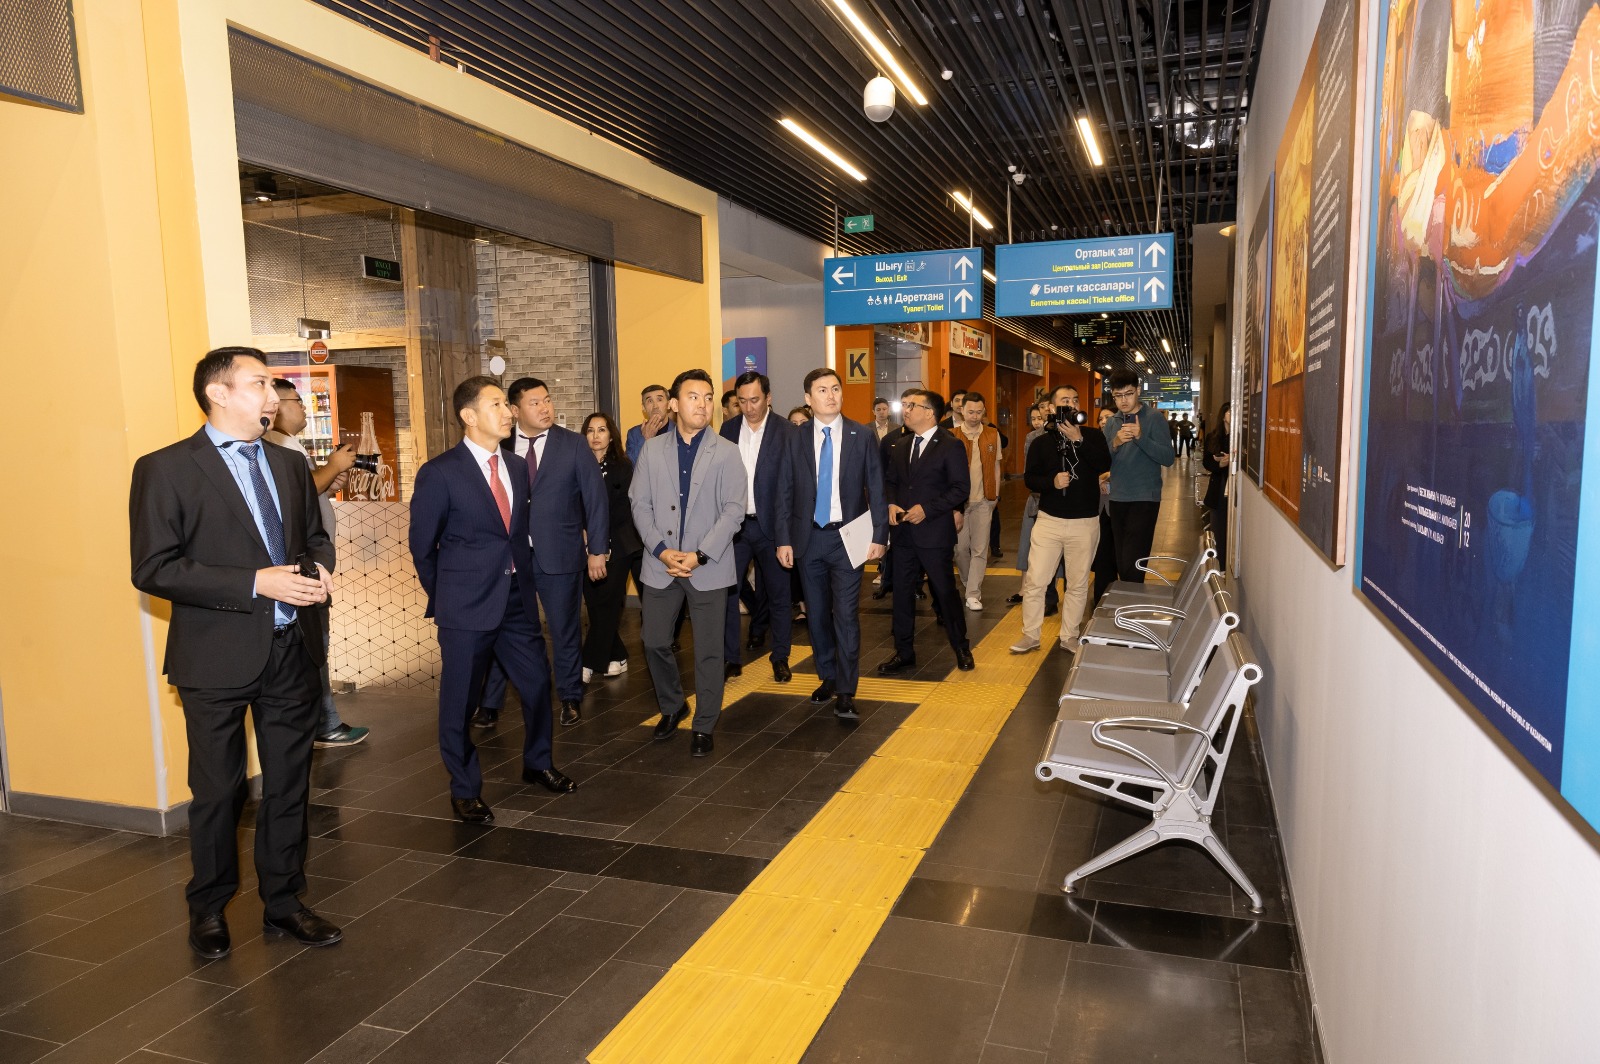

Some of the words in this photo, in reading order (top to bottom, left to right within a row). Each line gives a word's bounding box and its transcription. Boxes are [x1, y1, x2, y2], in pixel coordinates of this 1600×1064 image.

[1074, 248, 1116, 260] Орталық
[1117, 247, 1134, 256] зал
[875, 261, 903, 272] Шығу
[1103, 260, 1134, 269] Concourse
[875, 275, 893, 283] Выход
[896, 274, 908, 282] Exit
[1043, 283, 1074, 294] Билет
[1076, 281, 1135, 293] кассалары
[894, 292, 944, 304] Дәретхана
[1030, 298, 1065, 307] Билетные
[1066, 297, 1089, 305] кассы
[1115, 295, 1135, 303] office
[903, 305, 924, 314] Туалет
[926, 303, 944, 312] Toilet
[1464, 511, 1471, 528] 20
[1463, 530, 1470, 548] 12
